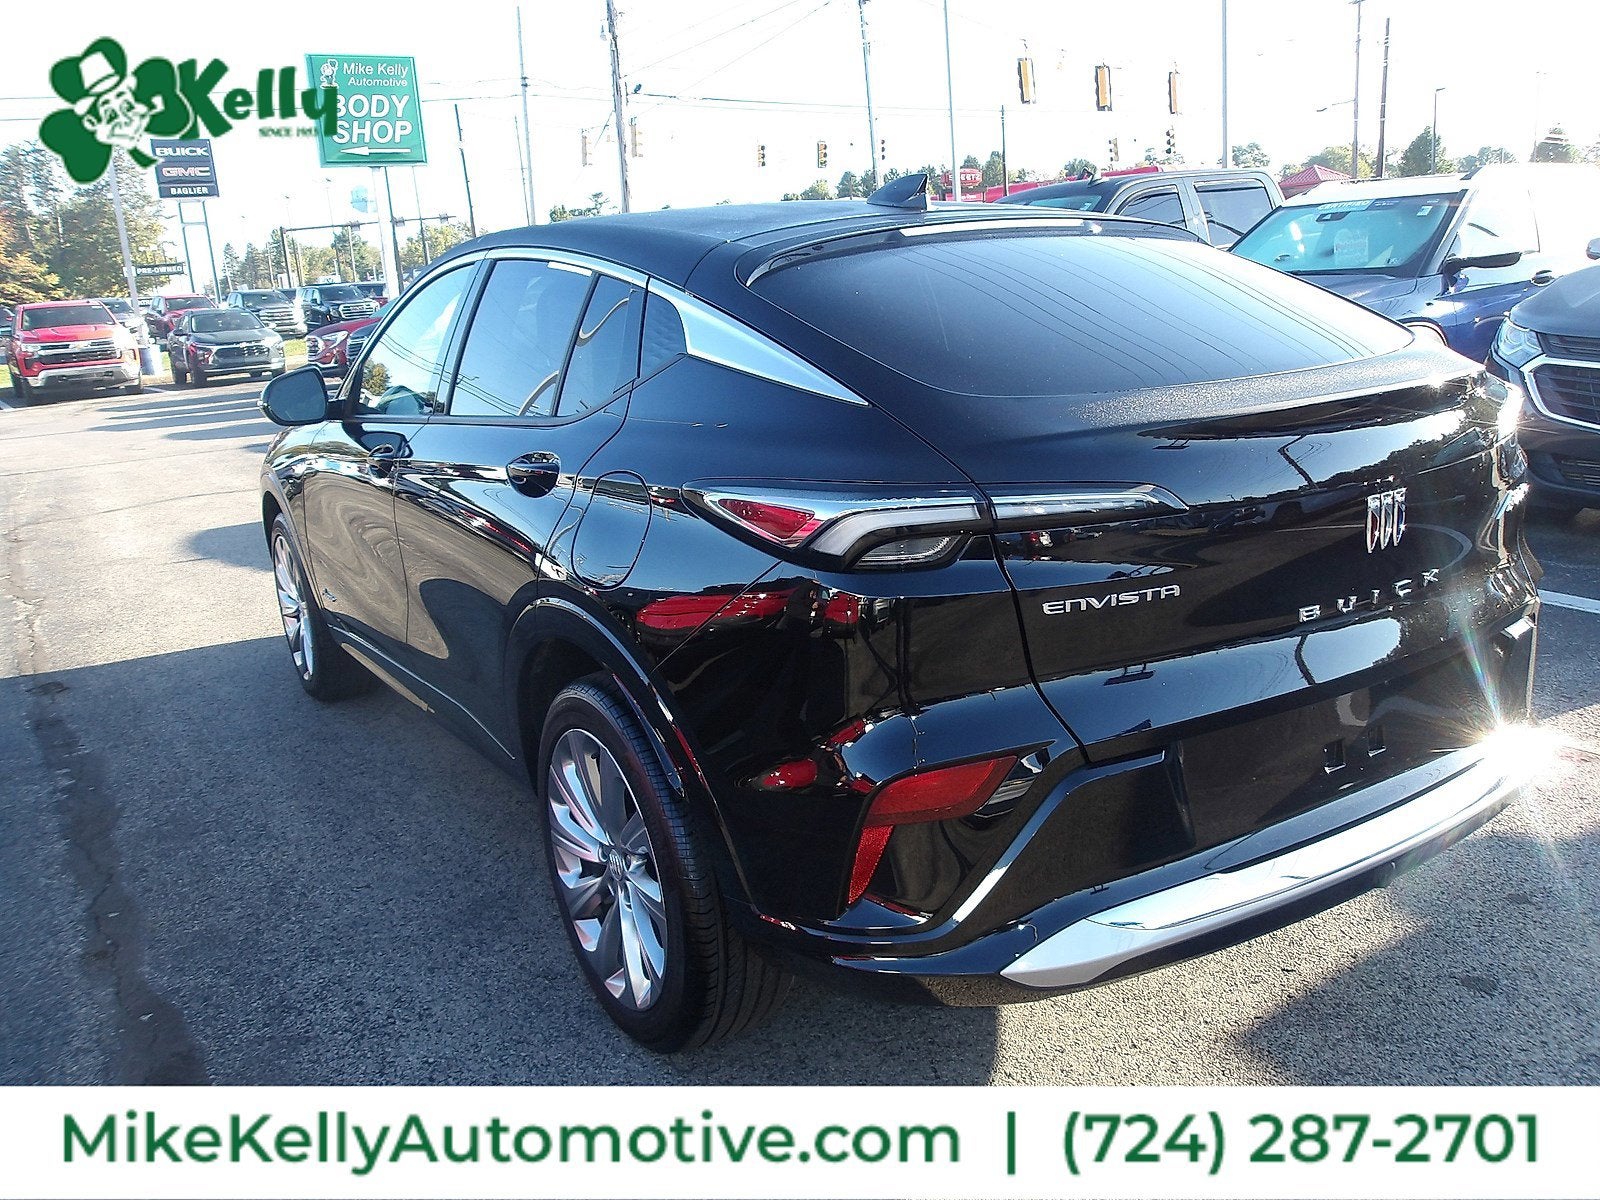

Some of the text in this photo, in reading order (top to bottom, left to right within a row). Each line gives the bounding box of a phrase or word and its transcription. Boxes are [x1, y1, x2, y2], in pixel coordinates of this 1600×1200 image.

[343, 62, 409, 79] Mike Kelly
[347, 77, 409, 88] Automotive
[331, 120, 413, 144] SHOP
[155, 147, 210, 157] BUICK
[162, 166, 211, 177] GMC
[170, 186, 209, 195] BAGLIER
[136, 265, 183, 275] PRE-OWNED
[1042, 584, 1181, 615] ENVISTA
[1299, 568, 1440, 623] BUICK
